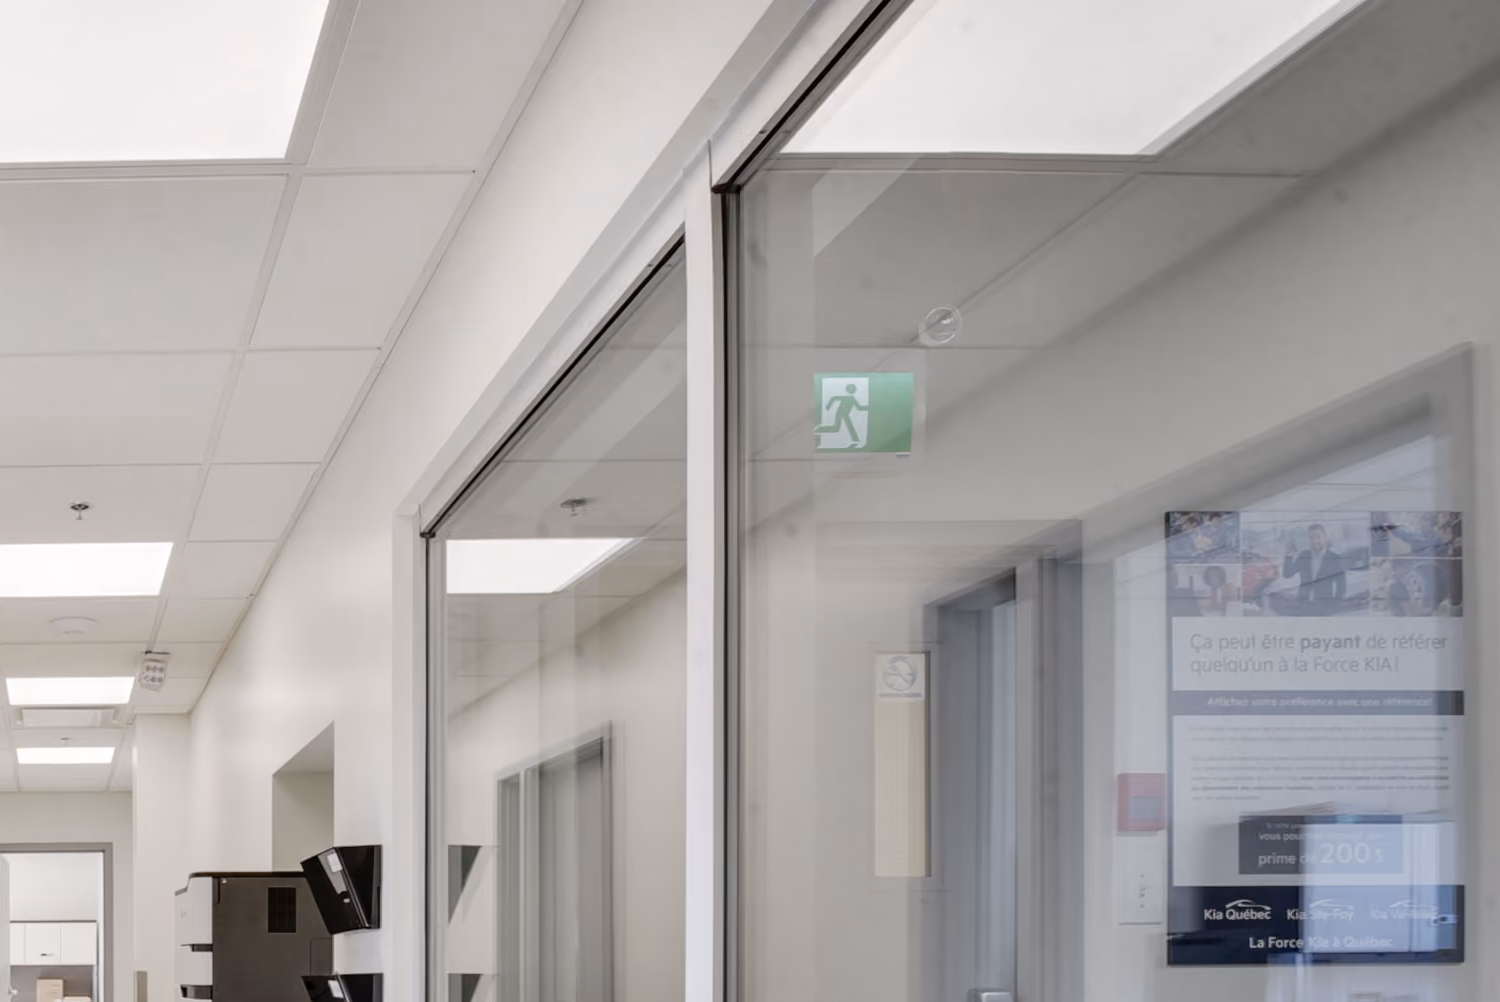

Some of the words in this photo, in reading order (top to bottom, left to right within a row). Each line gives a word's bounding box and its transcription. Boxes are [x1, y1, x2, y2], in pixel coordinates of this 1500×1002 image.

[1190, 633, 1213, 653] Ça
[1219, 633, 1256, 653] peut
[1262, 633, 1296, 650] être
[1300, 634, 1361, 653] payant
[1366, 633, 1388, 650] de
[1392, 633, 1448, 650] référer
[1279, 656, 1289, 673] à
[1295, 656, 1309, 673] la
[1314, 656, 1360, 673] Force
[1258, 833, 1281, 841] vous
[1257, 852, 1296, 867] prime
[1319, 841, 1370, 864] 200
[1203, 908, 1223, 920] Kia
[1225, 908, 1272, 920] Québec
[1286, 908, 1307, 920] Kia
[1249, 936, 1265, 949] La
[1268, 936, 1304, 949] Force
[1308, 936, 1330, 948] Kia
[1344, 935, 1393, 948] Québec
